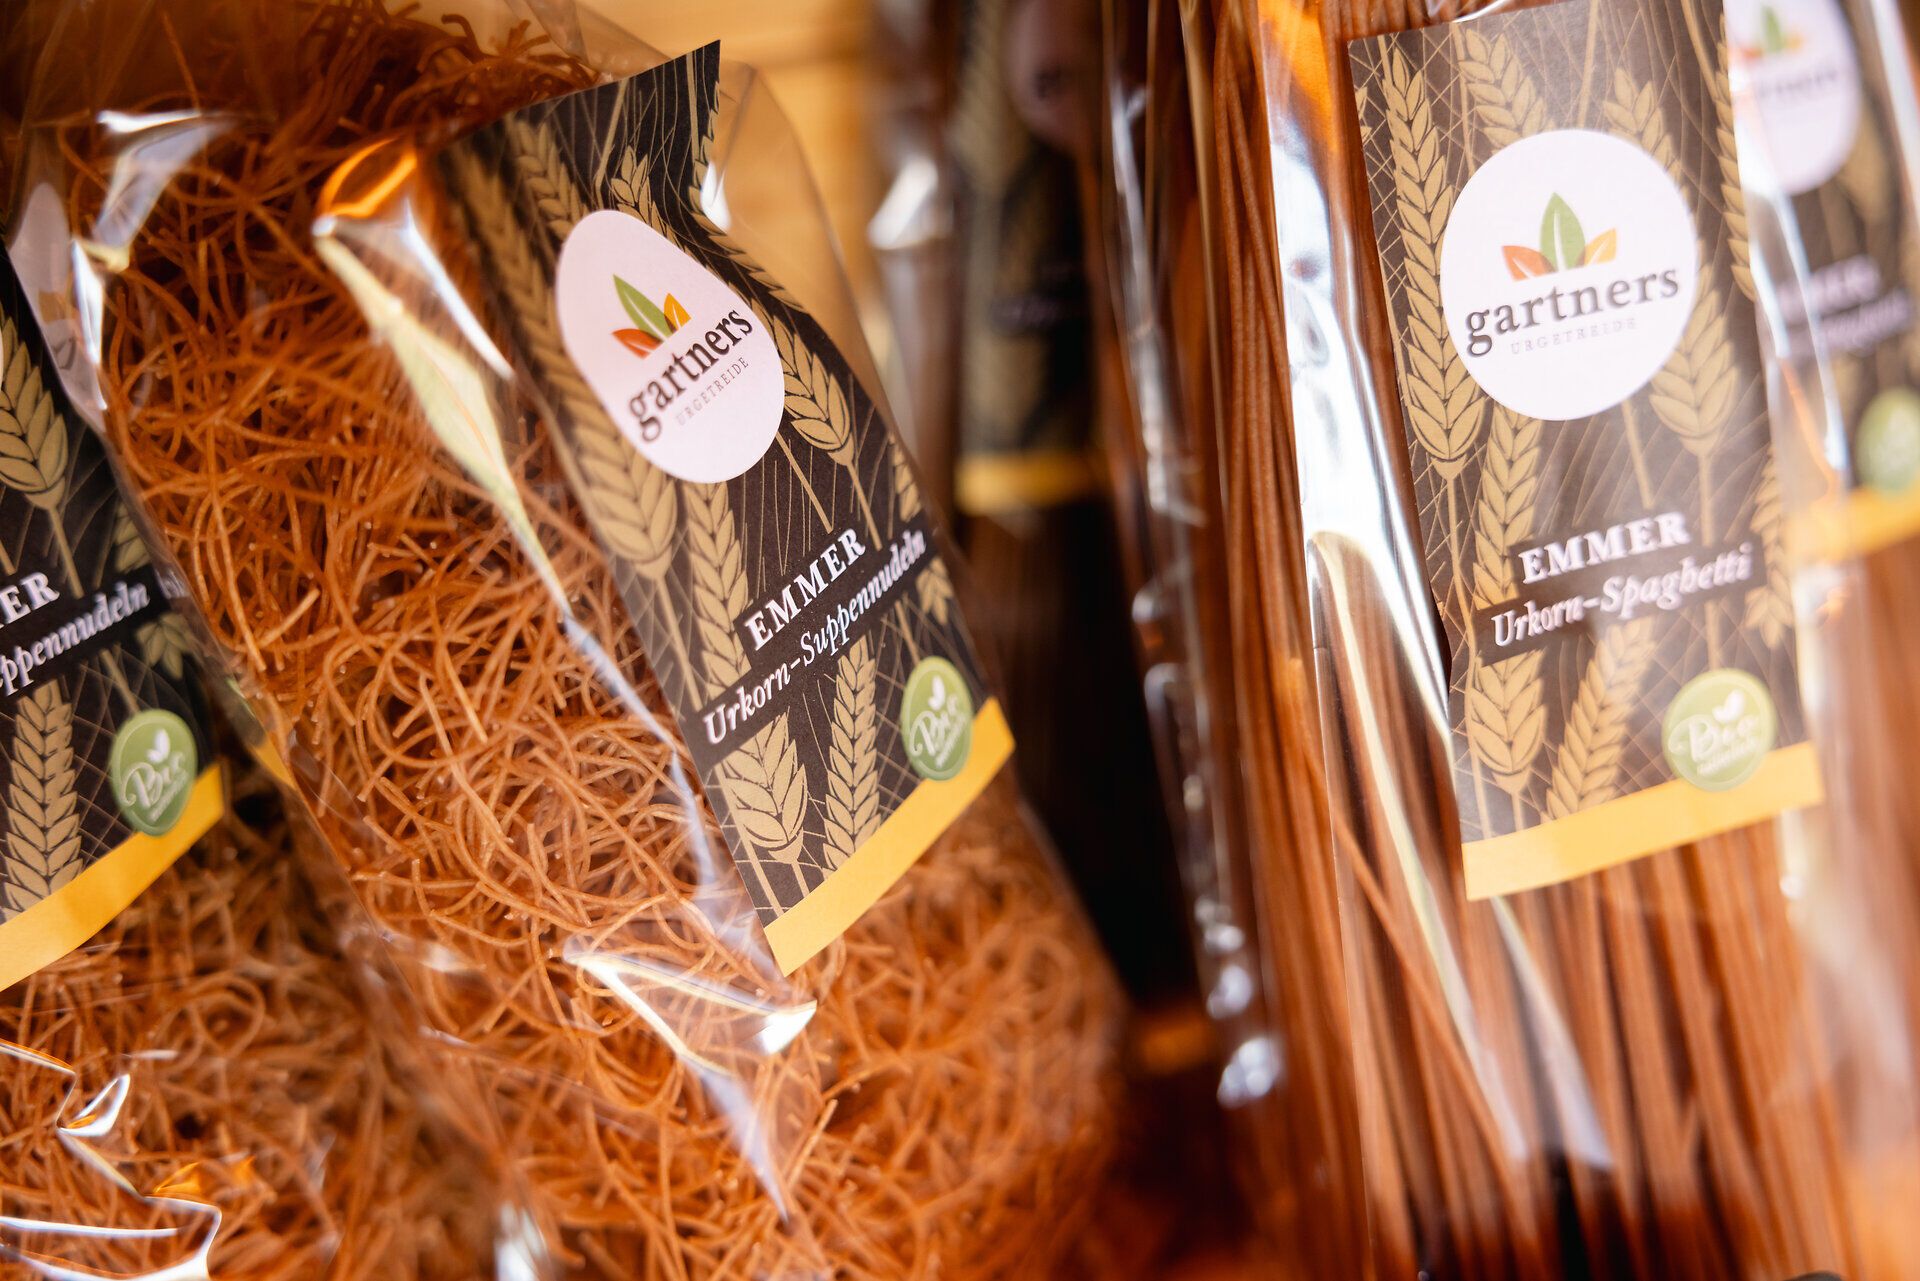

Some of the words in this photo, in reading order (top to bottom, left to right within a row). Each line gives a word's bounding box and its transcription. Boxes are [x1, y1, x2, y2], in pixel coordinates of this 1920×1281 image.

[1465, 268, 1680, 358] gartners
[1510, 316, 1638, 354] URGETREIDE
[628, 309, 753, 443] gartners
[675, 356, 749, 426] URGETREIDE
[744, 528, 866, 651] EMMER
[1491, 542, 1754, 647] Urkorn-Spaghetti
[1518, 511, 1691, 584] EMMER
[0, 571, 61, 629] ER
[0, 580, 150, 696] ppennudeln
[702, 530, 927, 744] Urkorn-Suppennudeln
